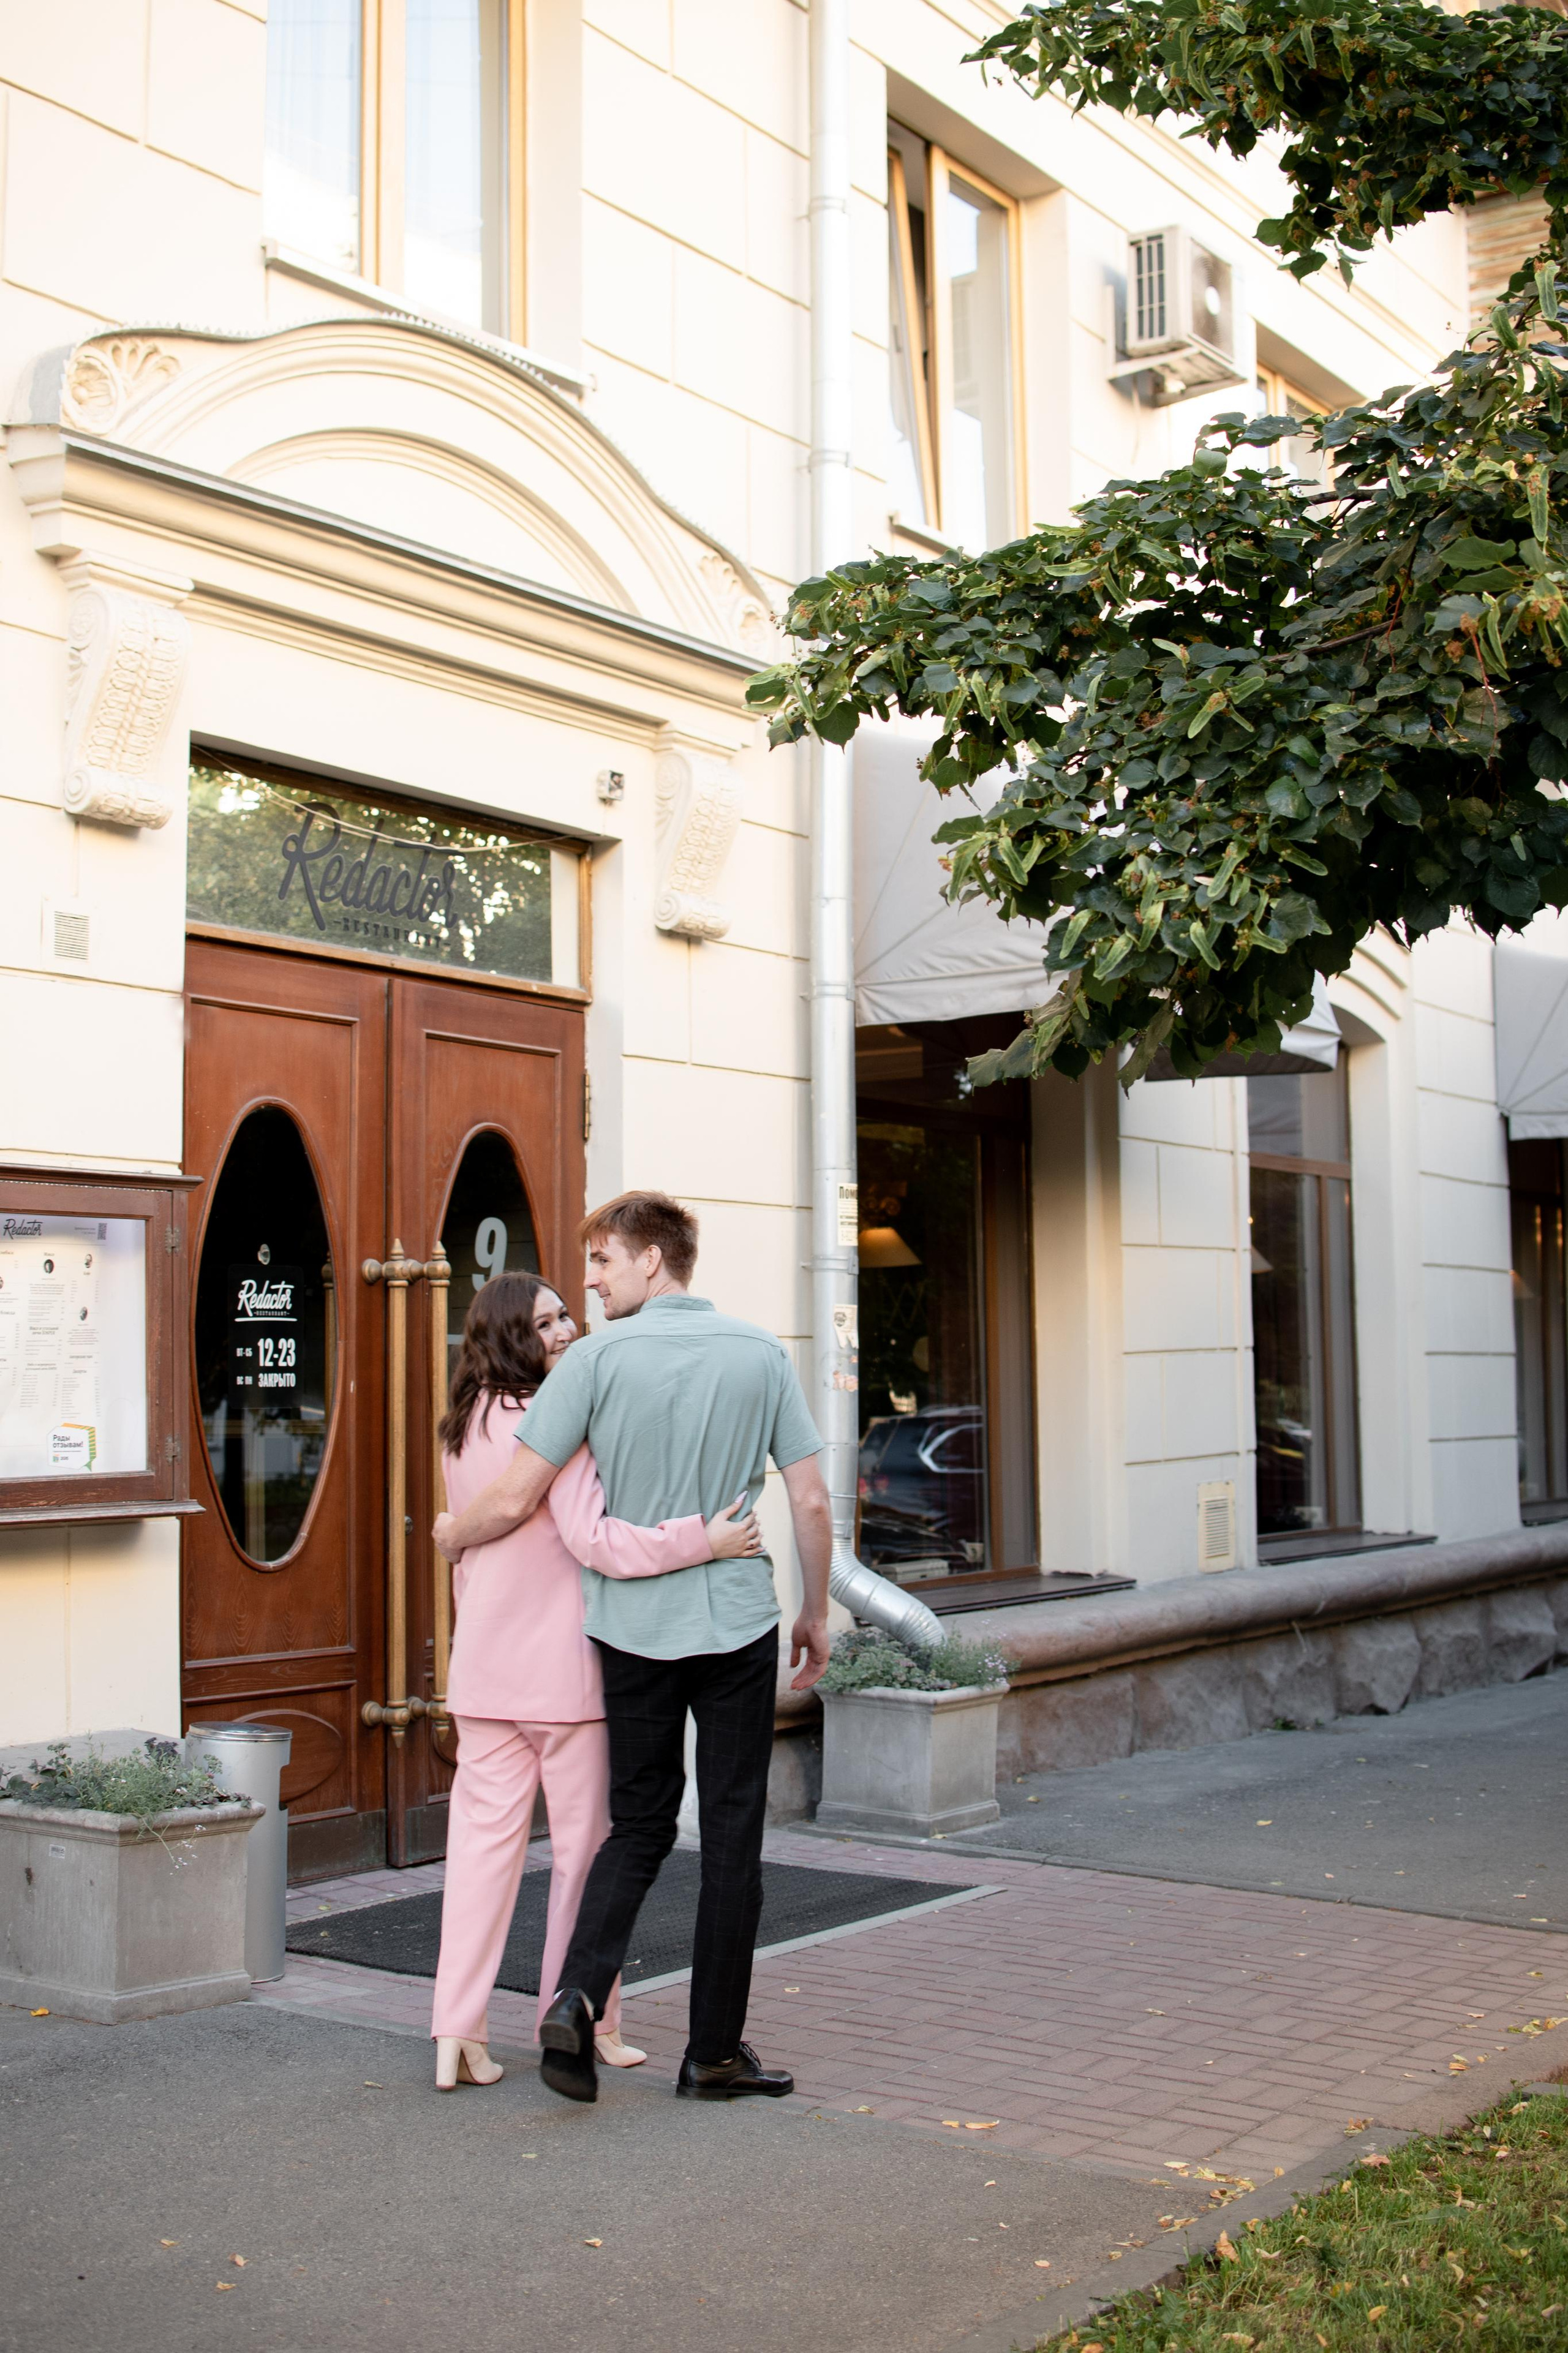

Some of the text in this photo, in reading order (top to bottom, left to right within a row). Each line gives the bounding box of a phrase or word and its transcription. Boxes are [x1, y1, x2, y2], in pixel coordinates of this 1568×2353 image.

[279, 802, 466, 932] Redactor
[3, 1219, 43, 1240] Redactor
[472, 1217, 507, 1292] 9
[237, 1279, 295, 1317] Redactor
[257, 1338, 296, 1366] 12-23
[258, 1373, 296, 1387] ЗАКРЫТО
